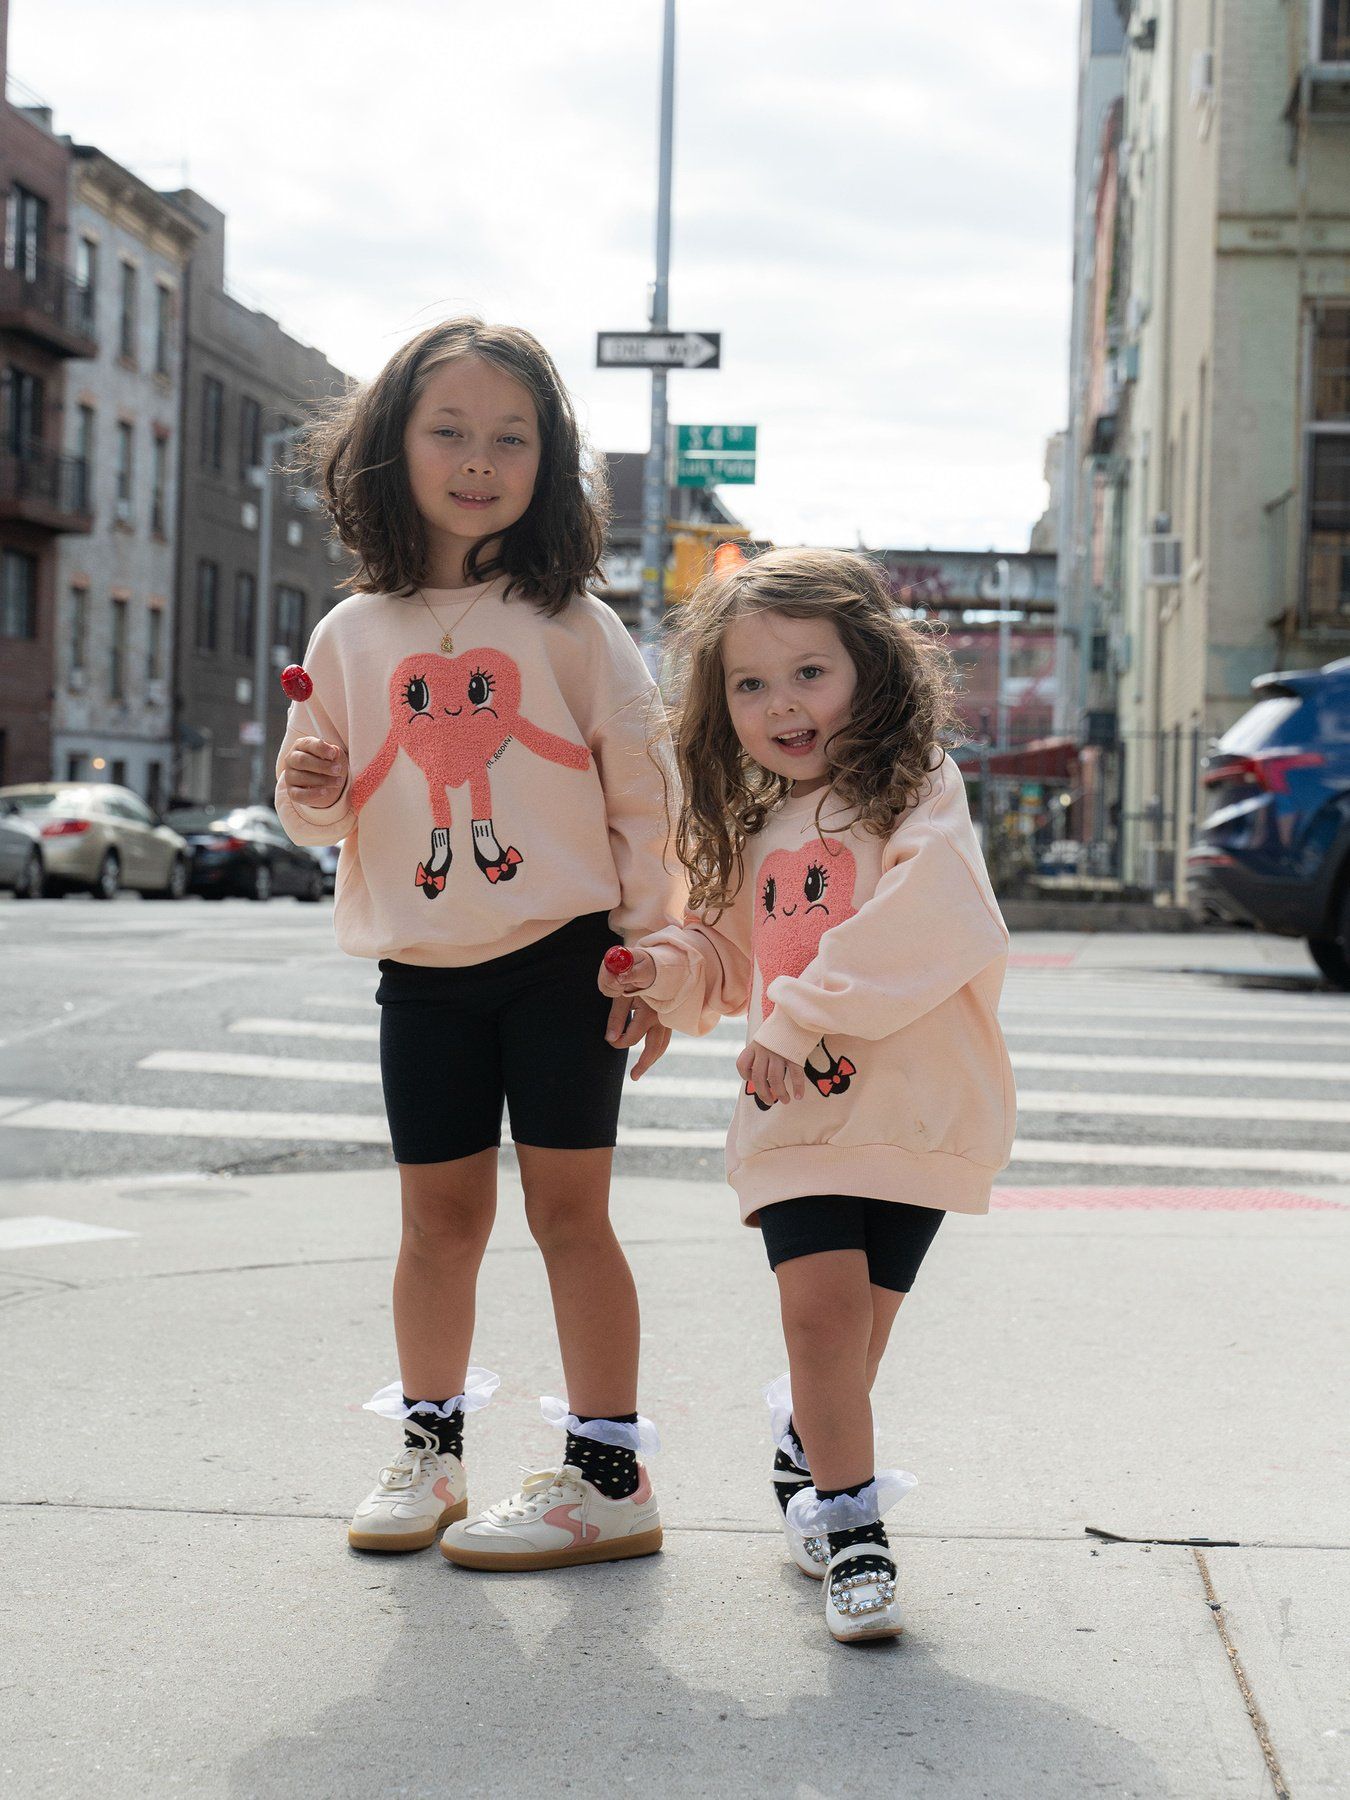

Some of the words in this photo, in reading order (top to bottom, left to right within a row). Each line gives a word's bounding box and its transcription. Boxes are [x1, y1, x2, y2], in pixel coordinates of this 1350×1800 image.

[613, 341, 648, 358] ONE
[666, 341, 703, 358] WAY
[707, 426, 724, 449] 4
